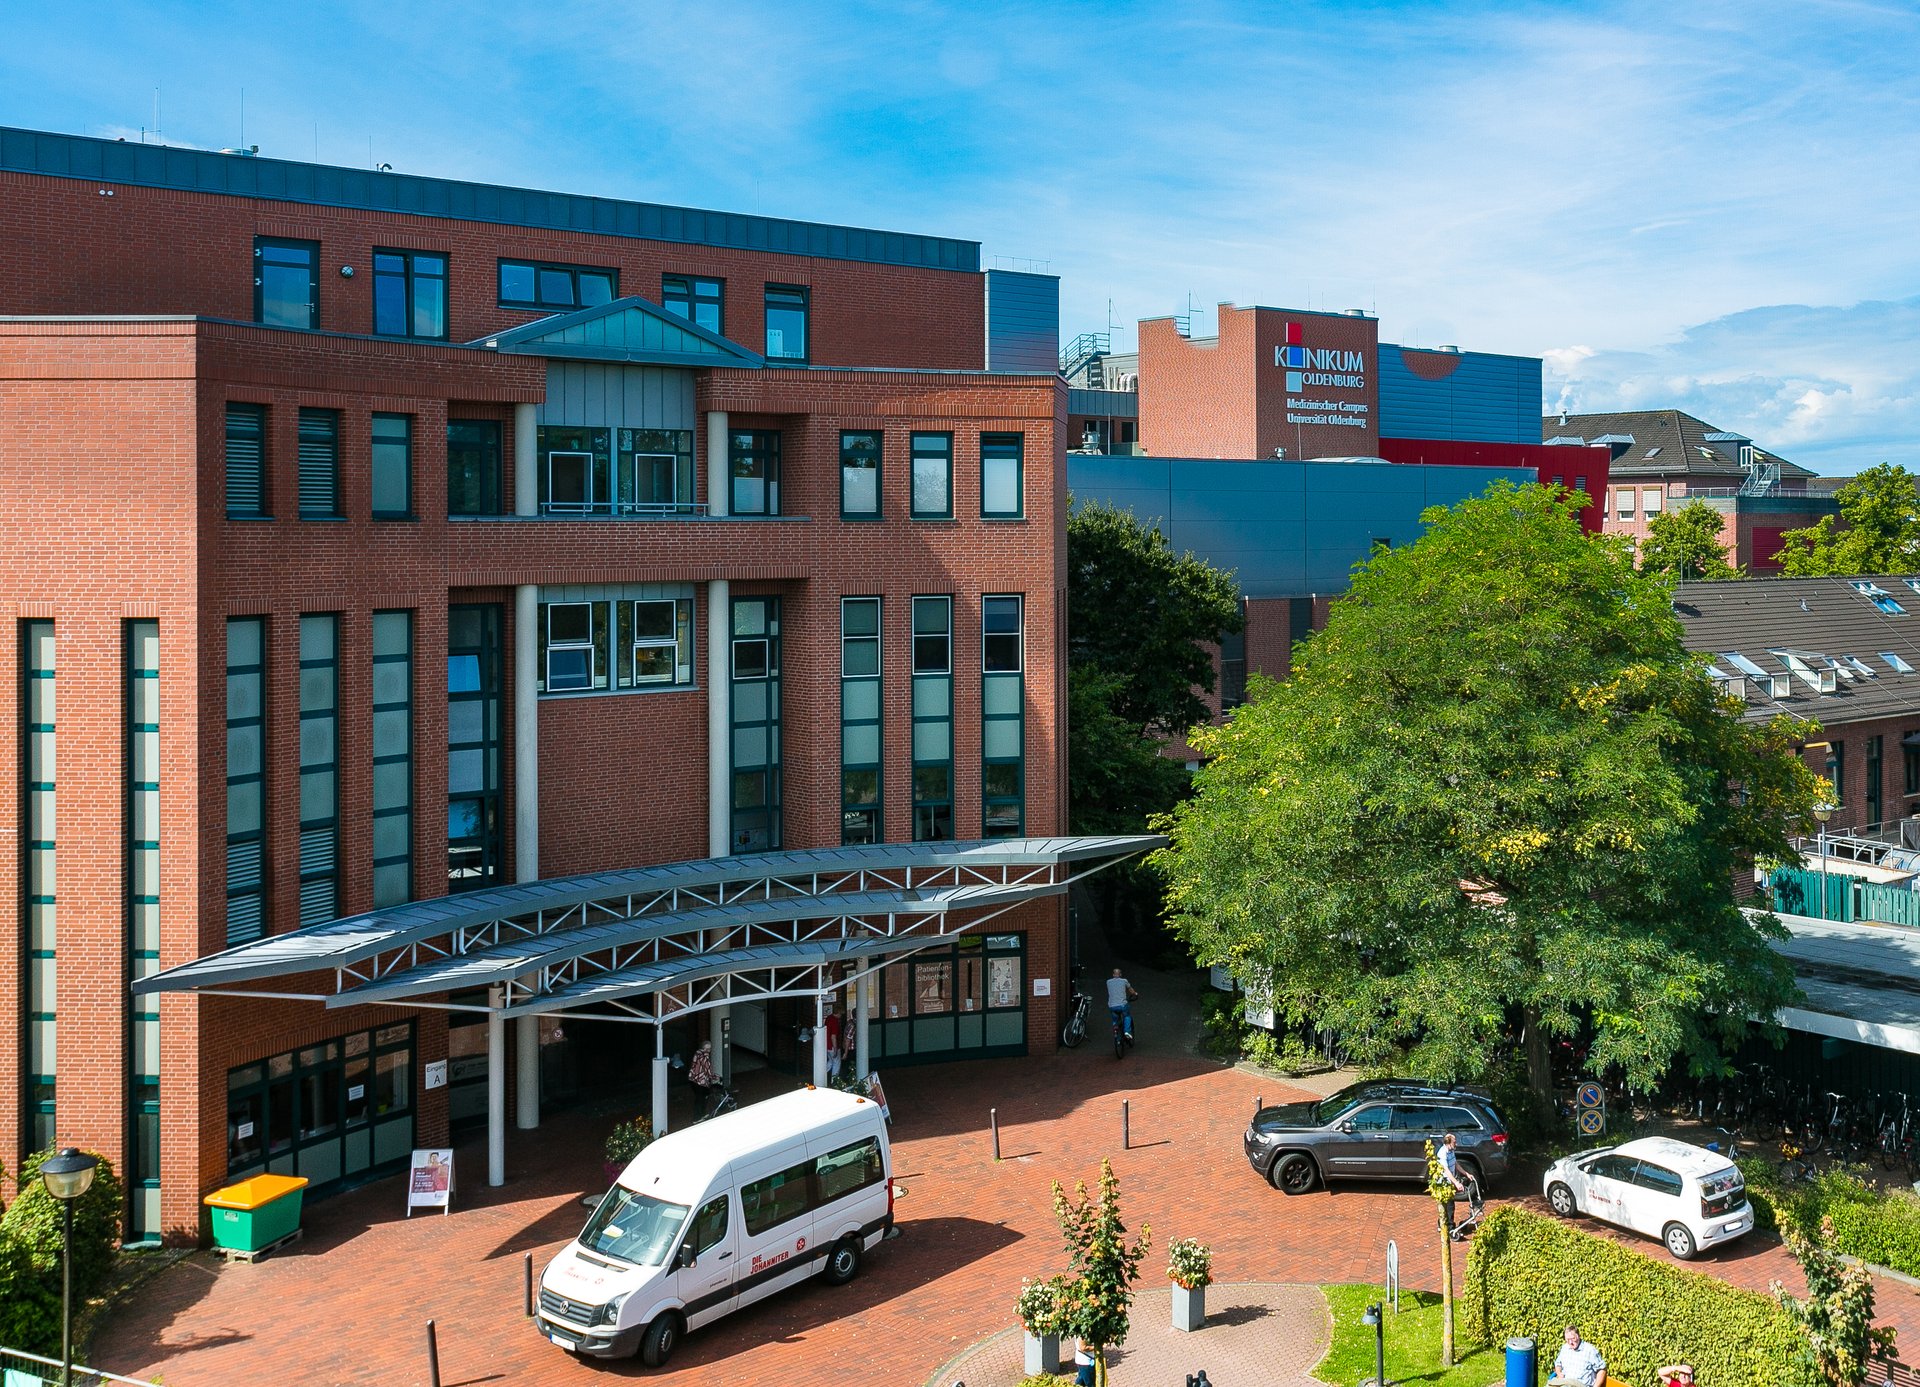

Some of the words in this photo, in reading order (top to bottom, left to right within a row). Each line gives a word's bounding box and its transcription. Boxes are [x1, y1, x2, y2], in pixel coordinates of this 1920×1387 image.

[1275, 346, 1364, 372] KLINIKUM
[1302, 372, 1364, 387] OLDENBURG
[1287, 398, 1337, 411] Medizinischer
[1338, 401, 1368, 414] Campus
[1287, 413, 1327, 425] Universität
[1328, 415, 1366, 429] Oldenburg
[427, 1063, 446, 1072] Eingang
[433, 1075, 441, 1085] A
[751, 1251, 789, 1273] JOHANNITER
[752, 1254, 762, 1265] DIE
